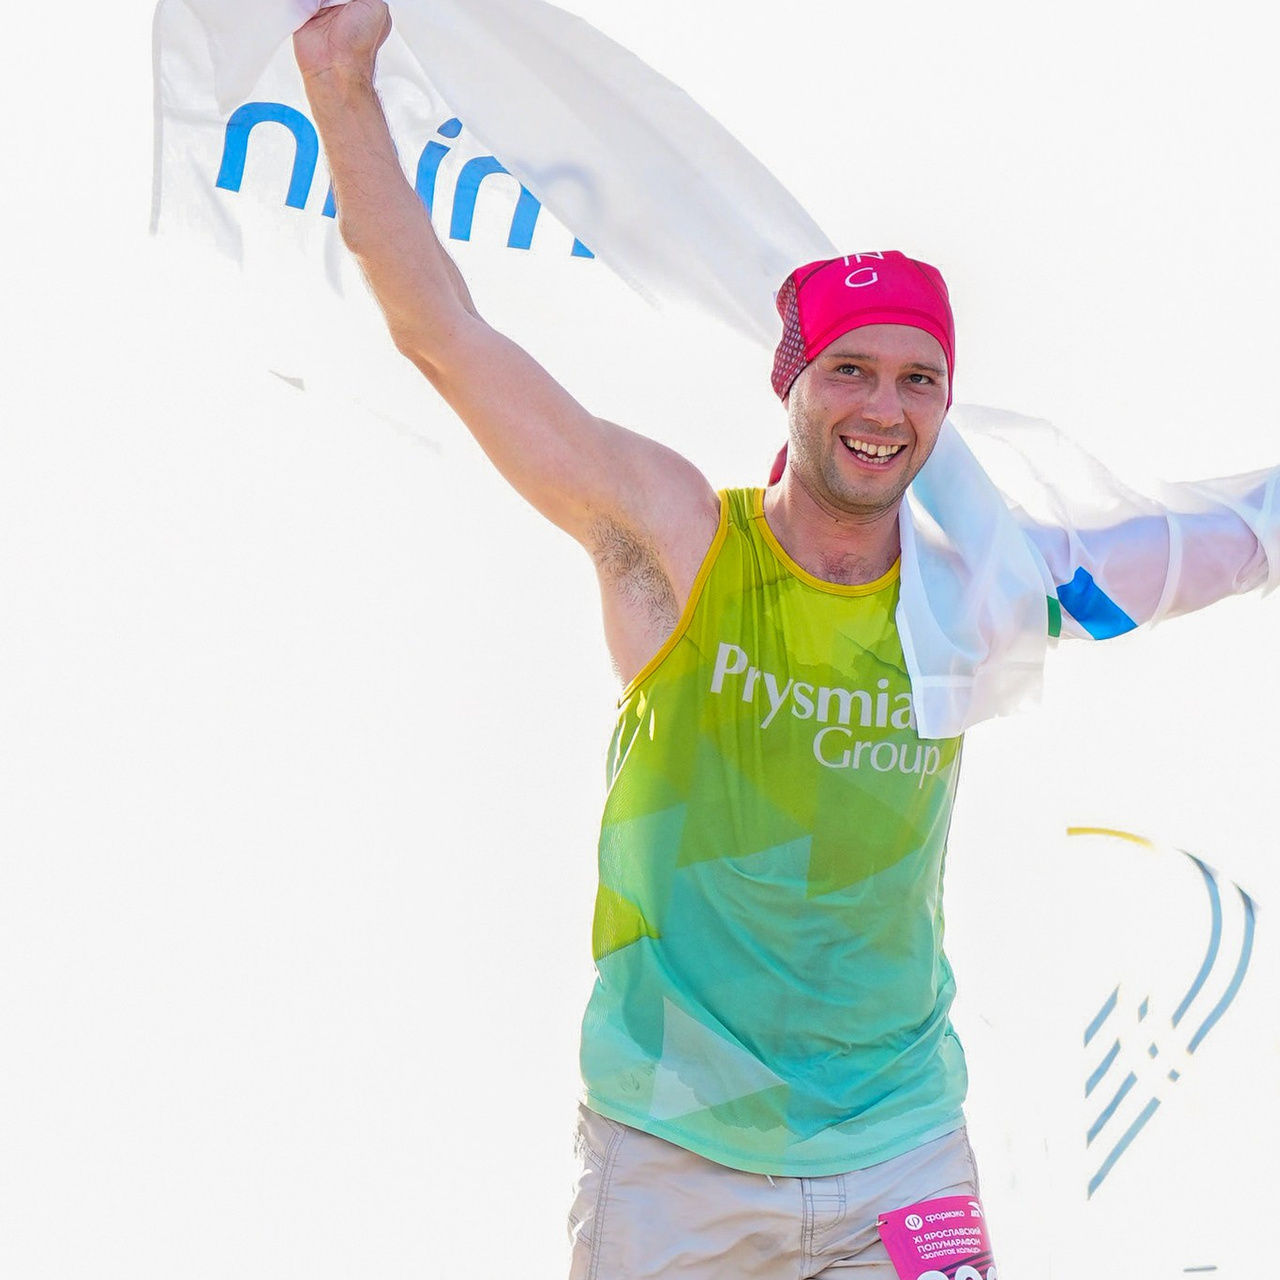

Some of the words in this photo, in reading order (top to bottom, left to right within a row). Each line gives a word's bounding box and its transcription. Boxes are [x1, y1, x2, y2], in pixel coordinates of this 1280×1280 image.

[710, 642, 918, 730] Prysmia
[813, 726, 941, 789] Group
[917, 1238, 981, 1253] ПОЛУМАРАФОН
[924, 1226, 982, 1241] ЯРОСЛАВСКИЙ
